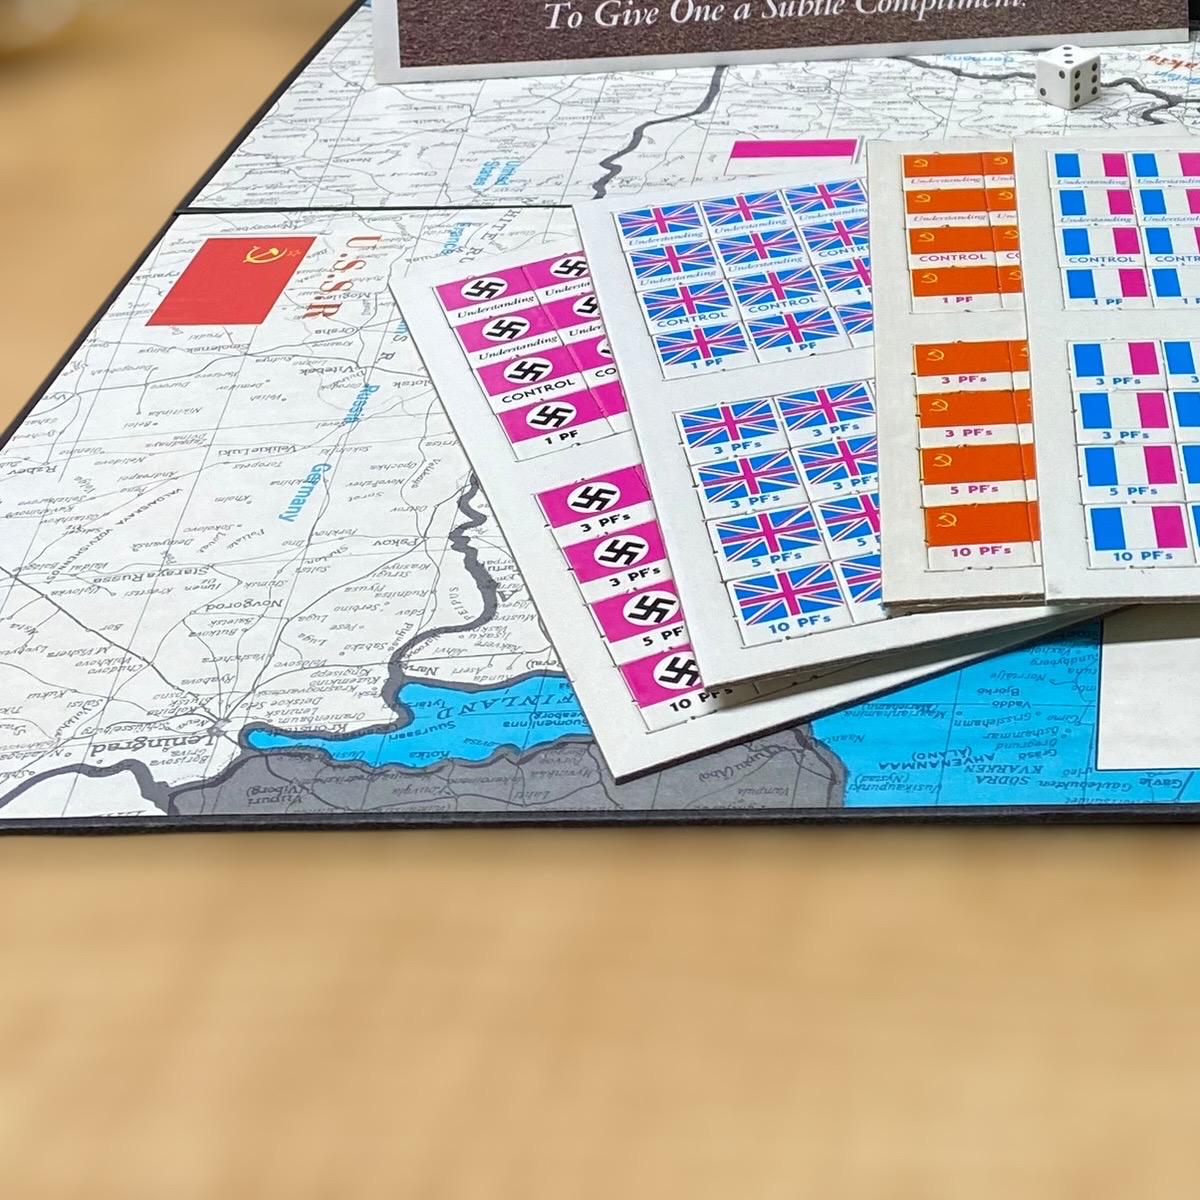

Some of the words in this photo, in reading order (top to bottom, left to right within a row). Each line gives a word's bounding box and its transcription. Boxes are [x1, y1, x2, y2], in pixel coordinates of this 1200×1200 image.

[544, 1, 582, 29] To
[594, 0, 659, 26] Give
[733, 3, 750, 20] a
[919, 253, 986, 262] CONTROL
[1068, 256, 1135, 265] CONTROL
[656, 310, 728, 328] CONTROL
[501, 378, 575, 403] CONTROL
[278, 463, 332, 523] Germany
[580, 523, 592, 532] 3
[951, 547, 971, 557] 10
[1113, 551, 1133, 561] 10
[768, 622, 790, 634] 10
[90, 735, 215, 757] Leningrad
